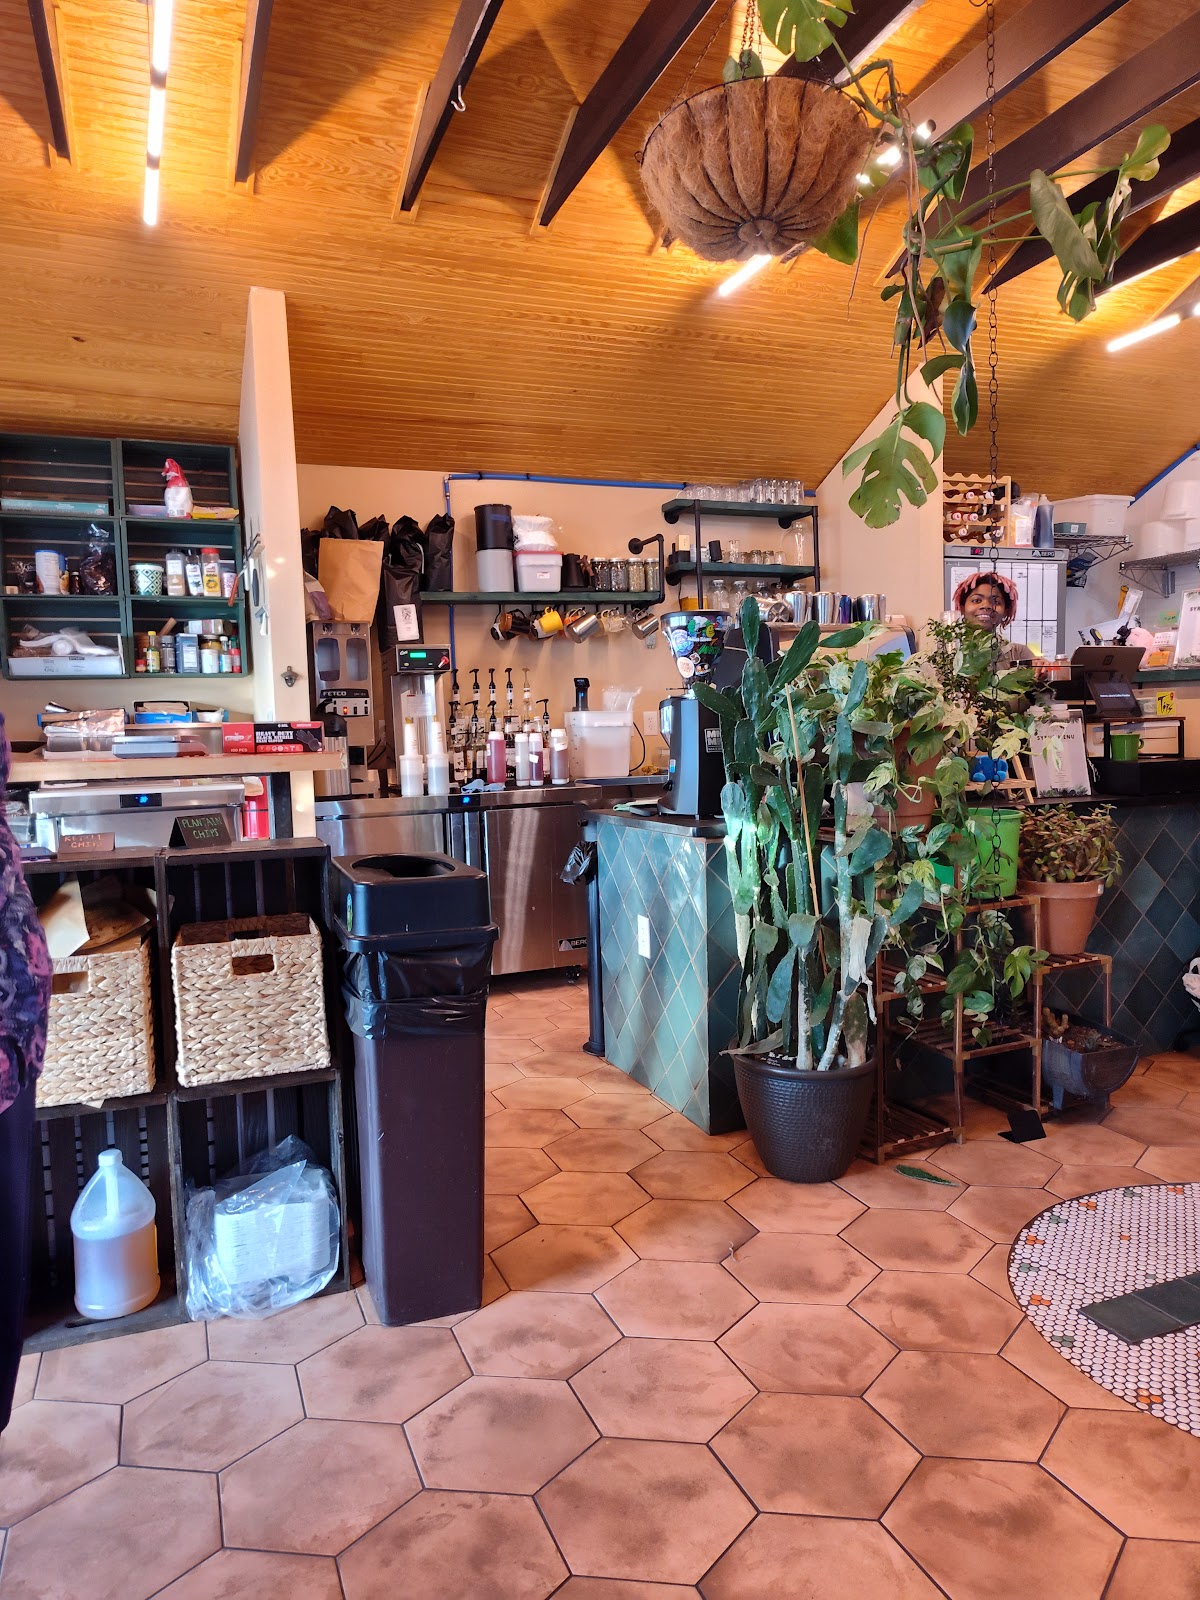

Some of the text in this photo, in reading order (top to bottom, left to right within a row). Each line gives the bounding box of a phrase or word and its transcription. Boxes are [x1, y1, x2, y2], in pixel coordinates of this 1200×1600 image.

[181, 816, 223, 828] PLANTAIN
[192, 828, 219, 839] CHIPS
[70, 841, 103, 849] CHIP
